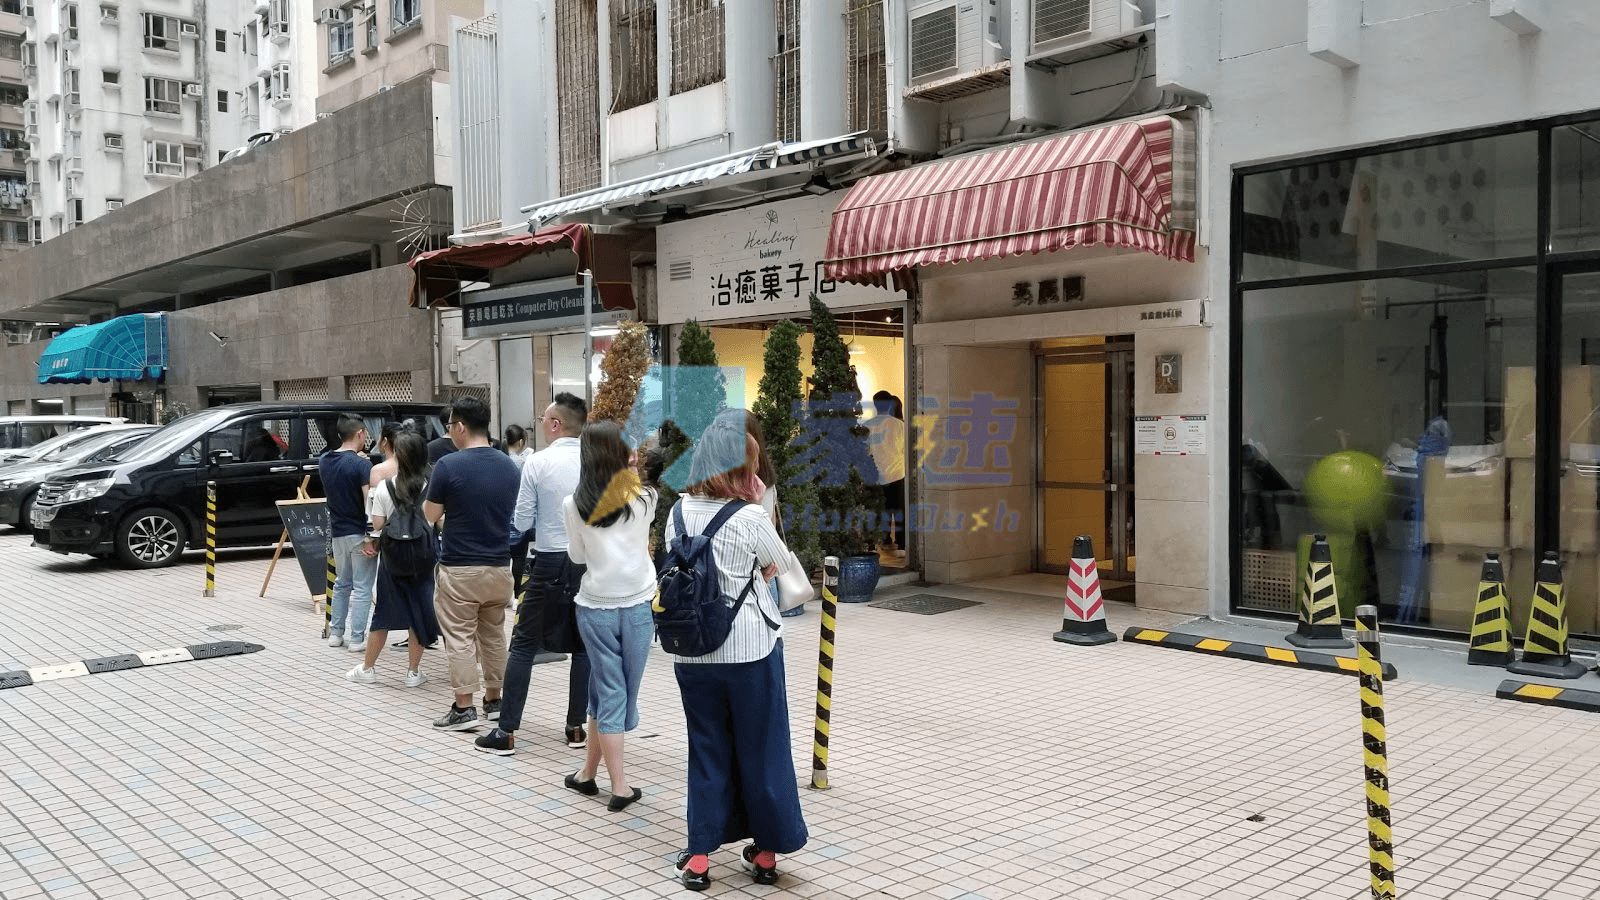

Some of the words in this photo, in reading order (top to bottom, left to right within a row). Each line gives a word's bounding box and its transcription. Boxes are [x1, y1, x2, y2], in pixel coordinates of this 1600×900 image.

[744, 230, 797, 250] Healing
[760, 248, 782, 260] bakery
[515, 301, 547, 315] Computer
[547, 298, 560, 312] Dry
[560, 294, 585, 309] Cleani
[1161, 362, 1173, 377] D
